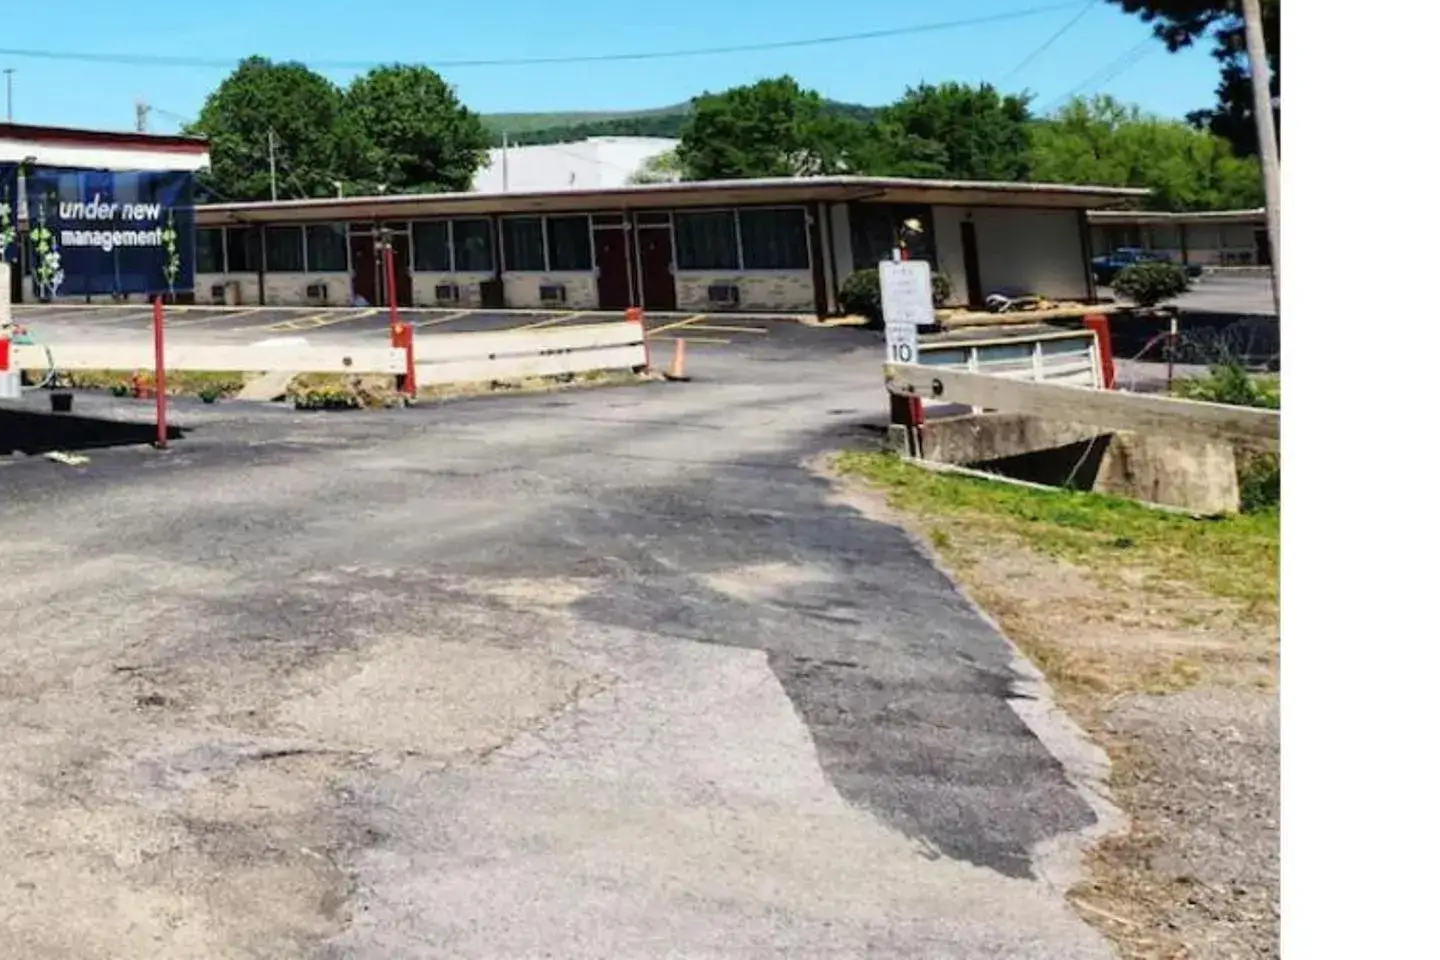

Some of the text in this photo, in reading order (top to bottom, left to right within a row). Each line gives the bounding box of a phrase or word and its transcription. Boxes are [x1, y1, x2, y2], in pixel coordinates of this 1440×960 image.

[59, 192, 162, 221] under new
[60, 226, 163, 252] management
[892, 343, 913, 363] 10
